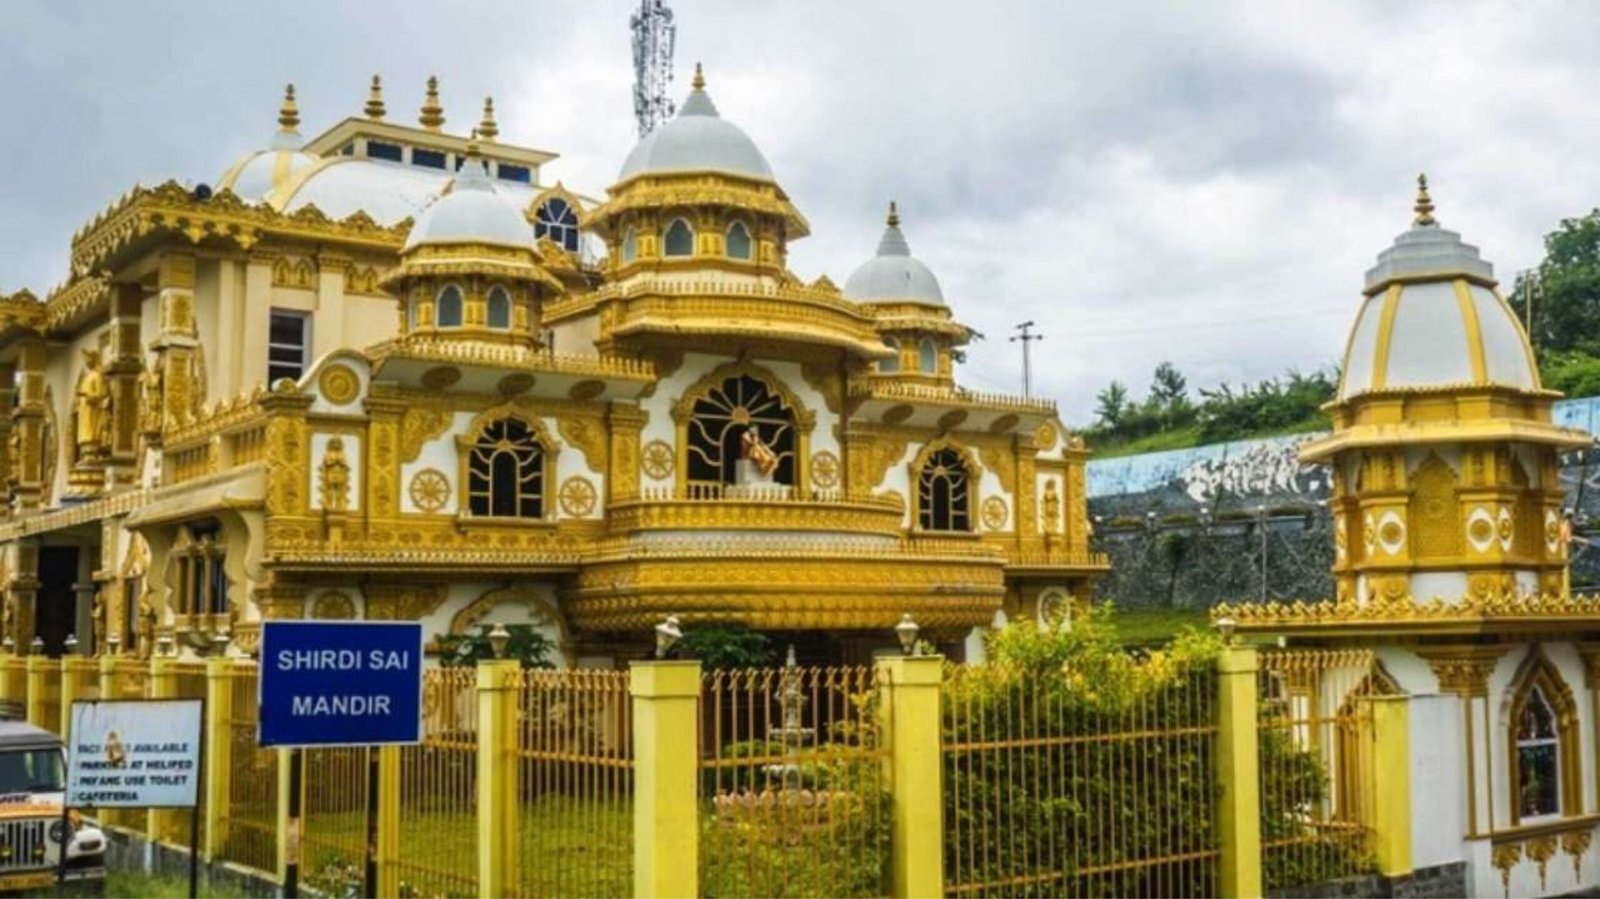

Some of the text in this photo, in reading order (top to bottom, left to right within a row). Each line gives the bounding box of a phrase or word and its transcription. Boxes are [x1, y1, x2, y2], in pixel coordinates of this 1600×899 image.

[277, 650, 409, 670] SHIRDI SAI
[292, 696, 391, 716] MANDIR
[133, 743, 188, 753] AVAILABLE
[131, 761, 143, 769] AT
[124, 775, 145, 785] USE
[149, 774, 188, 785] TOILET
